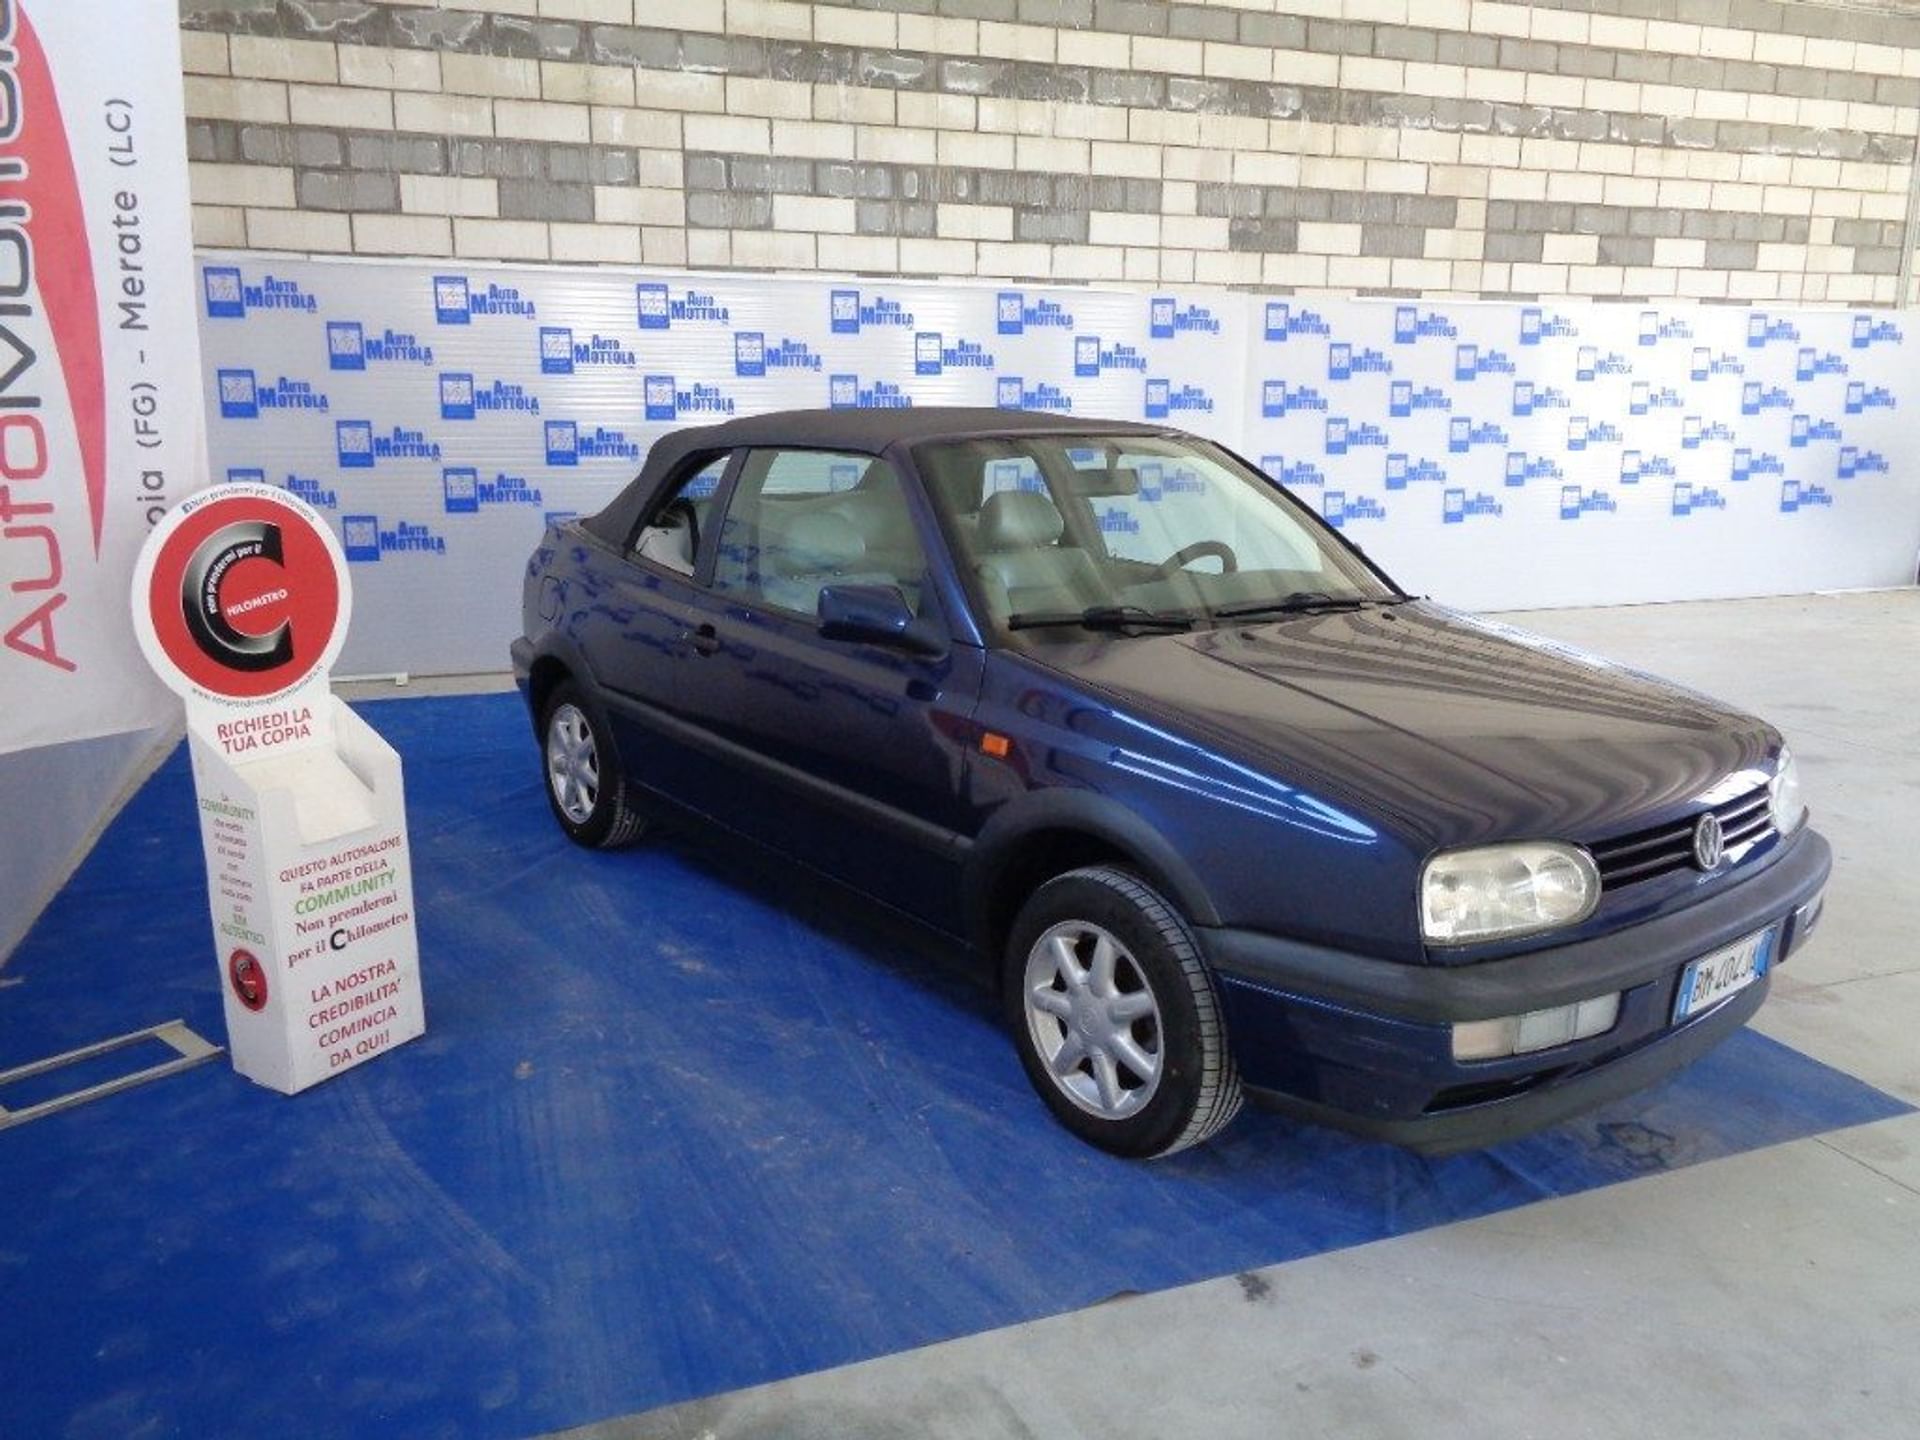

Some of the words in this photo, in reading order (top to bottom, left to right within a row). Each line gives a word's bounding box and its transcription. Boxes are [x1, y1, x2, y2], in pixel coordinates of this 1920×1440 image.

[104, 98, 136, 167] (LC)
[114, 190, 149, 331] Merate
[131, 382, 162, 448] (FG)
[217, 711, 288, 740] RICHIEDI
[292, 708, 312, 723] LA
[221, 735, 257, 755] TUA
[261, 724, 311, 746] COPIA
[279, 859, 327, 883] QUESTO
[330, 835, 401, 866] AUTOSALONE
[300, 882, 315, 893] FA
[316, 870, 353, 888] PARTE
[354, 858, 388, 877] DELLA
[295, 868, 396, 915] COMMUNITY
[295, 918, 324, 936] Non
[328, 889, 398, 928] prendermi
[288, 947, 312, 968] per
[316, 939, 326, 953] il
[330, 912, 409, 950] Chilometro
[308, 978, 401, 1028] CREDIBILITA'
[311, 985, 331, 1003] LA
[335, 959, 396, 995] NOSTRA
[319, 1005, 397, 1048] COMINCIA
[330, 1048, 352, 1068] DA
[356, 1029, 390, 1055] QUI!
